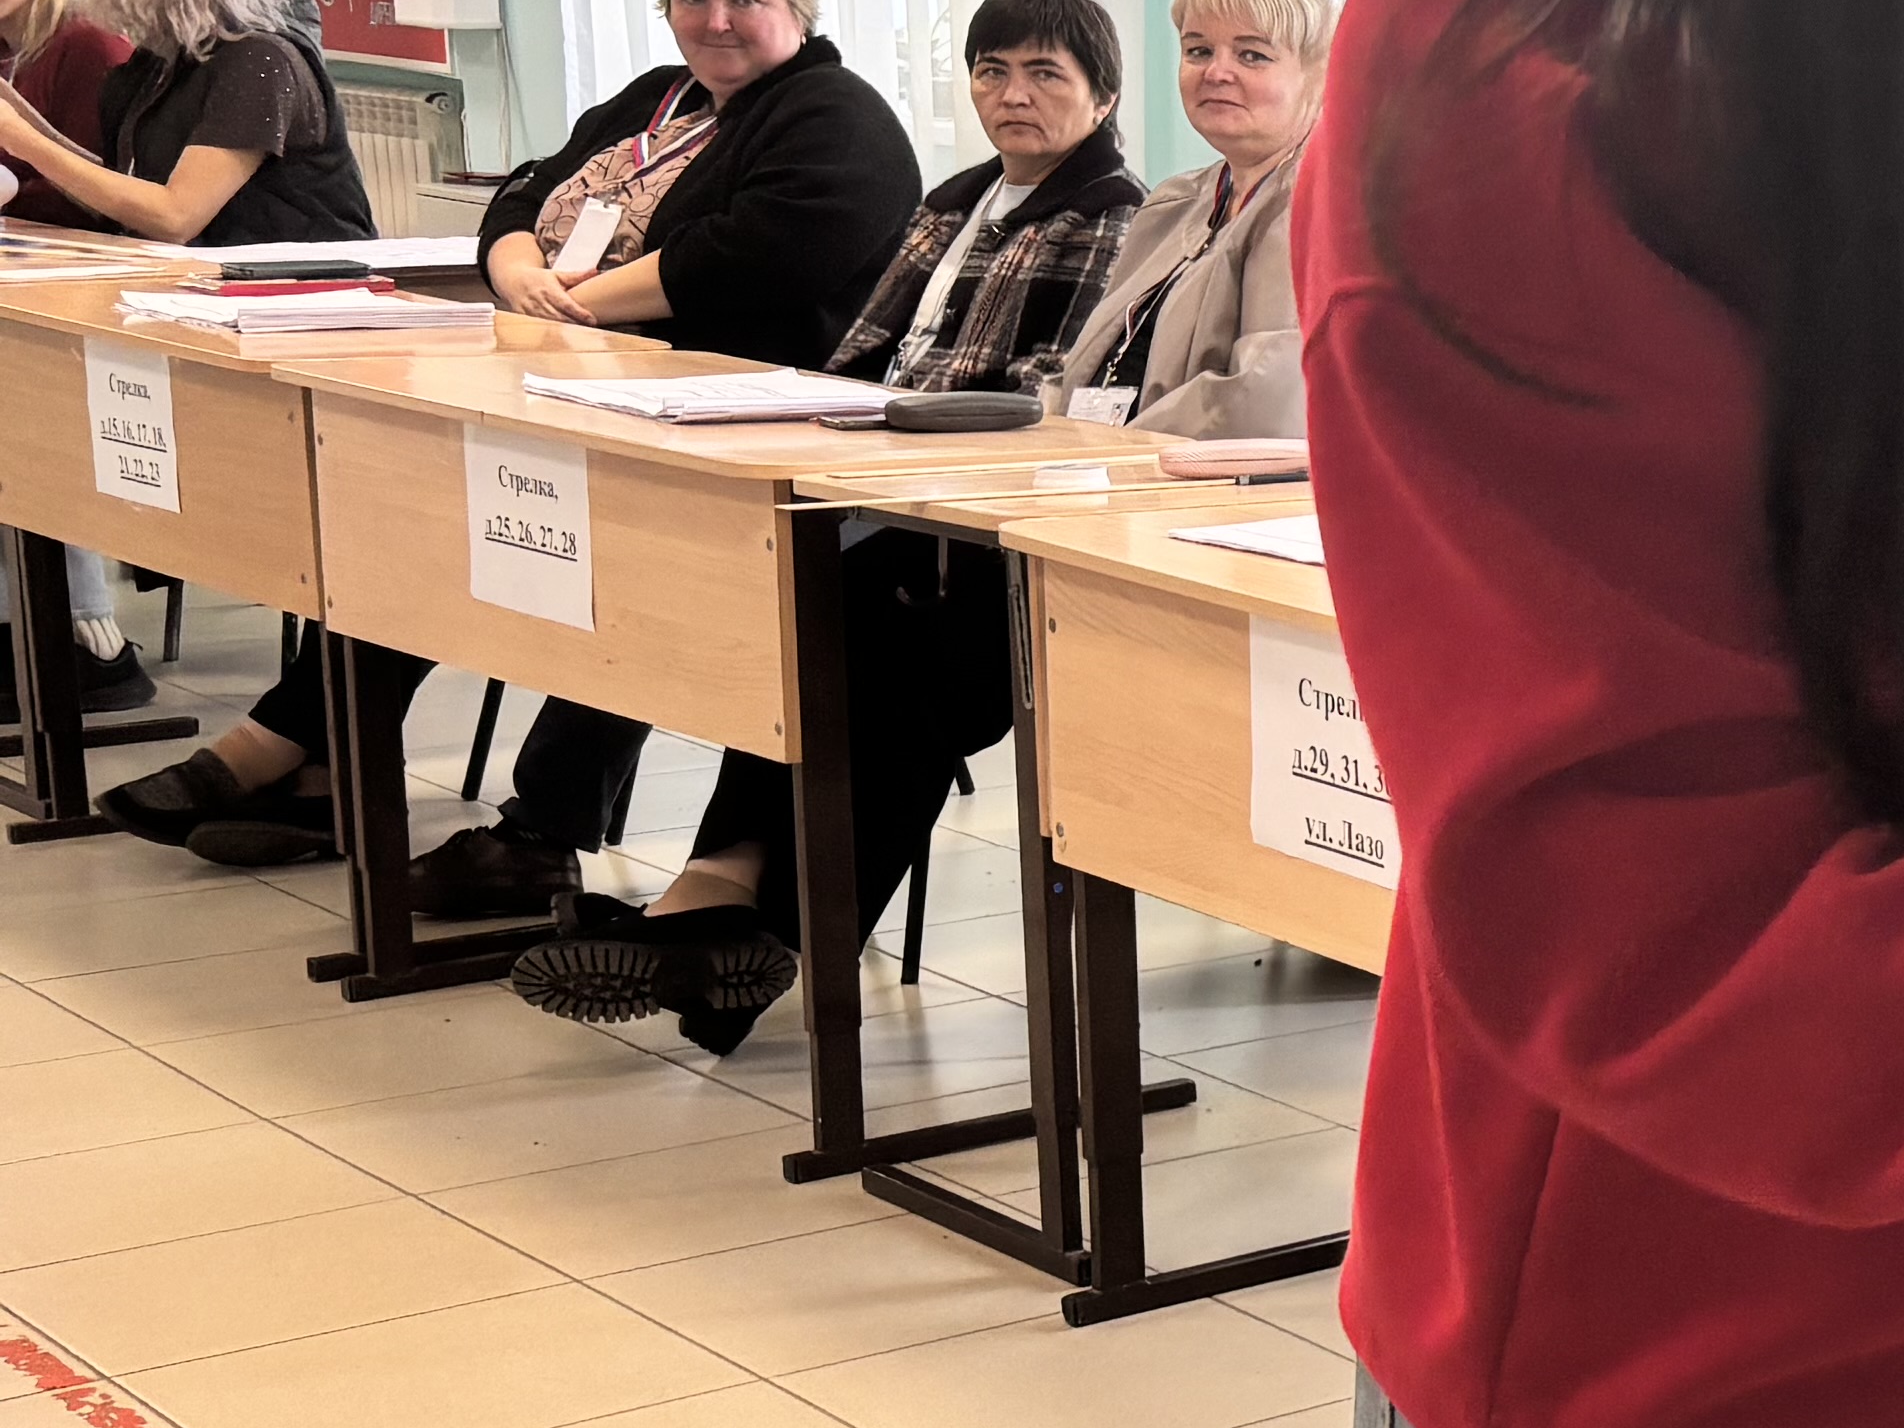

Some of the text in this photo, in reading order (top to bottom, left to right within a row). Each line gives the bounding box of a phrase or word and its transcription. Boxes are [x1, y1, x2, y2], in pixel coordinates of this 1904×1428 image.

[109, 373, 151, 400] Стрелка,
[498, 465, 558, 504] Стрелка,
[562, 531, 577, 555] 28
[1292, 745, 1336, 784] д.29,
[1341, 755, 1368, 790] 31,
[1305, 817, 1384, 860] ул. Лазо
